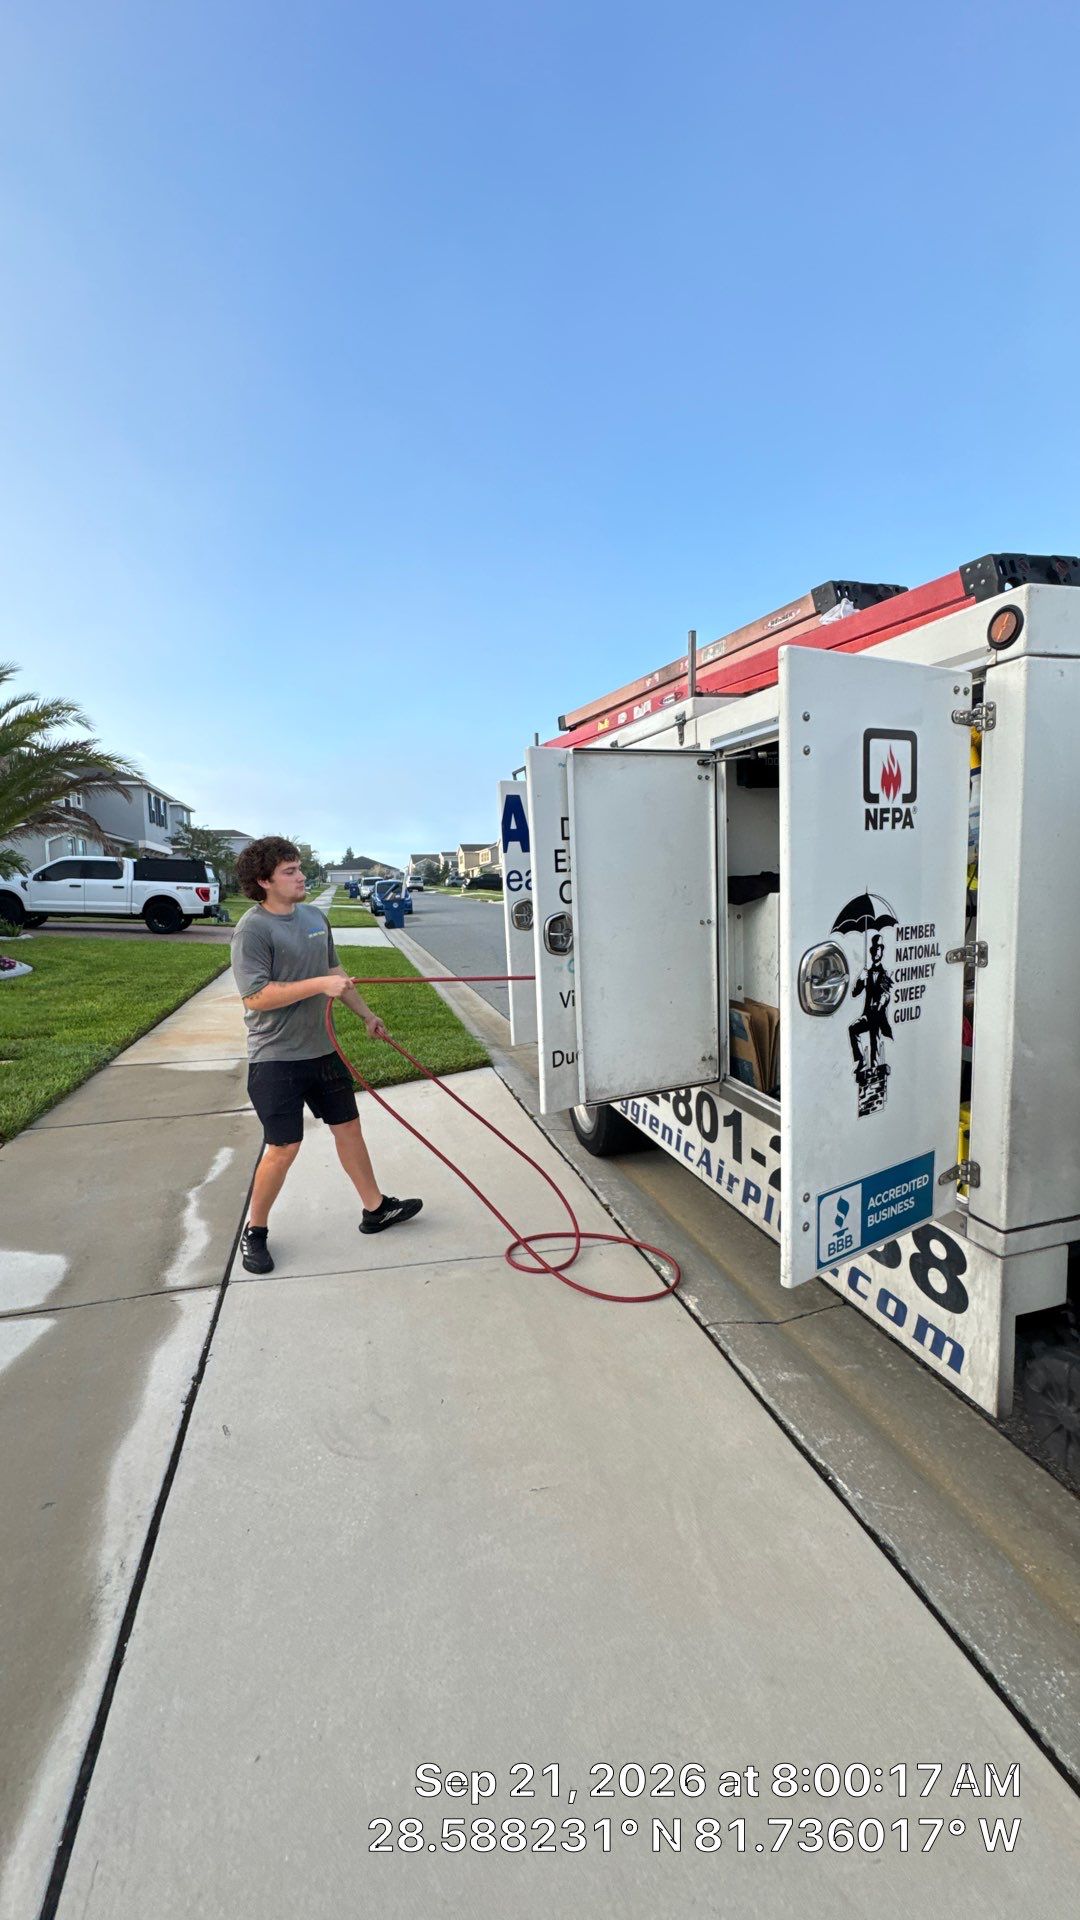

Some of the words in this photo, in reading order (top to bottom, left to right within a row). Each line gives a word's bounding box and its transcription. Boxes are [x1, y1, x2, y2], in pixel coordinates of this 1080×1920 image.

[895, 923, 936, 942] MEMBER
[895, 943, 941, 962] NATIONAL
[894, 963, 936, 983] CHIMNEY
[894, 985, 926, 1003] SWEEP
[894, 1006, 922, 1024] GUILD
[867, 1173, 930, 1210] ACCREDITED
[867, 1196, 915, 1228] BUSINESS
[827, 1234, 854, 1257] BBB
